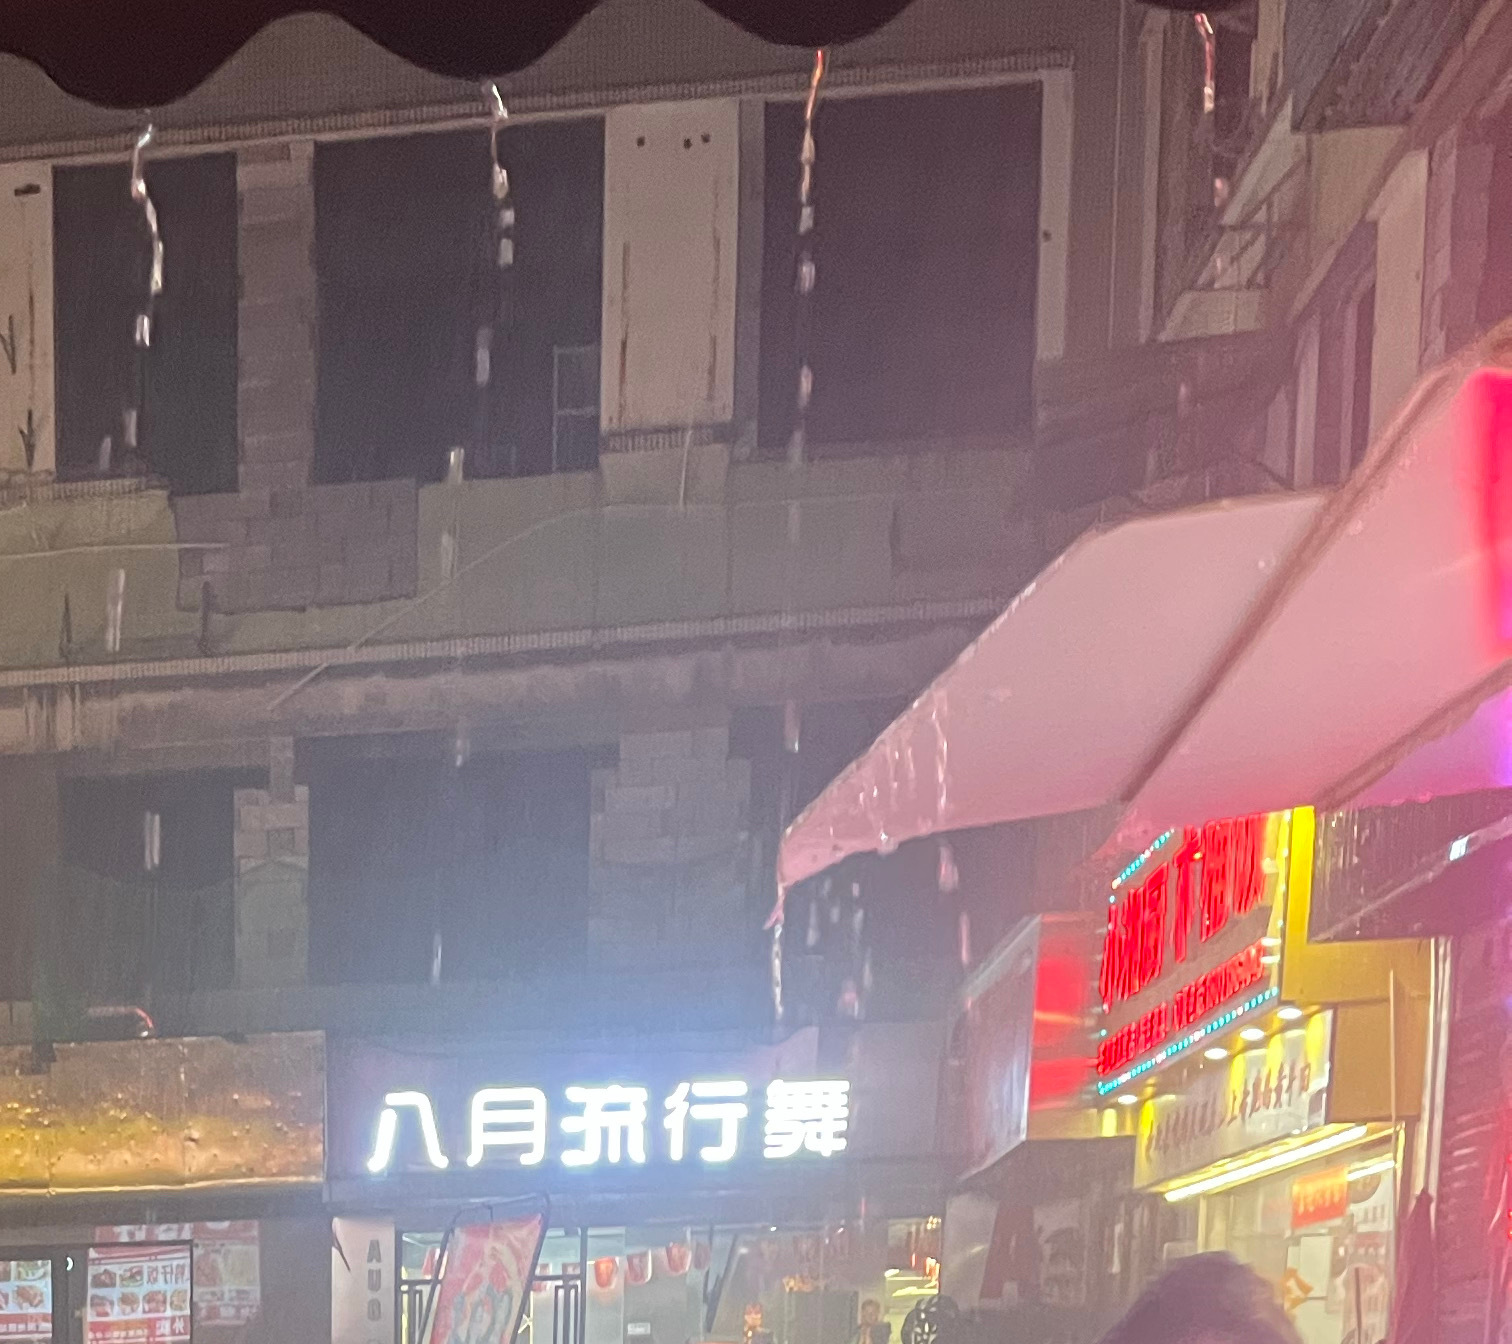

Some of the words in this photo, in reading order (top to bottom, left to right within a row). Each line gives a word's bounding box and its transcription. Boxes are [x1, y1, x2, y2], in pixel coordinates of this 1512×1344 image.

[367, 1078, 851, 1173] 八月流行舞
